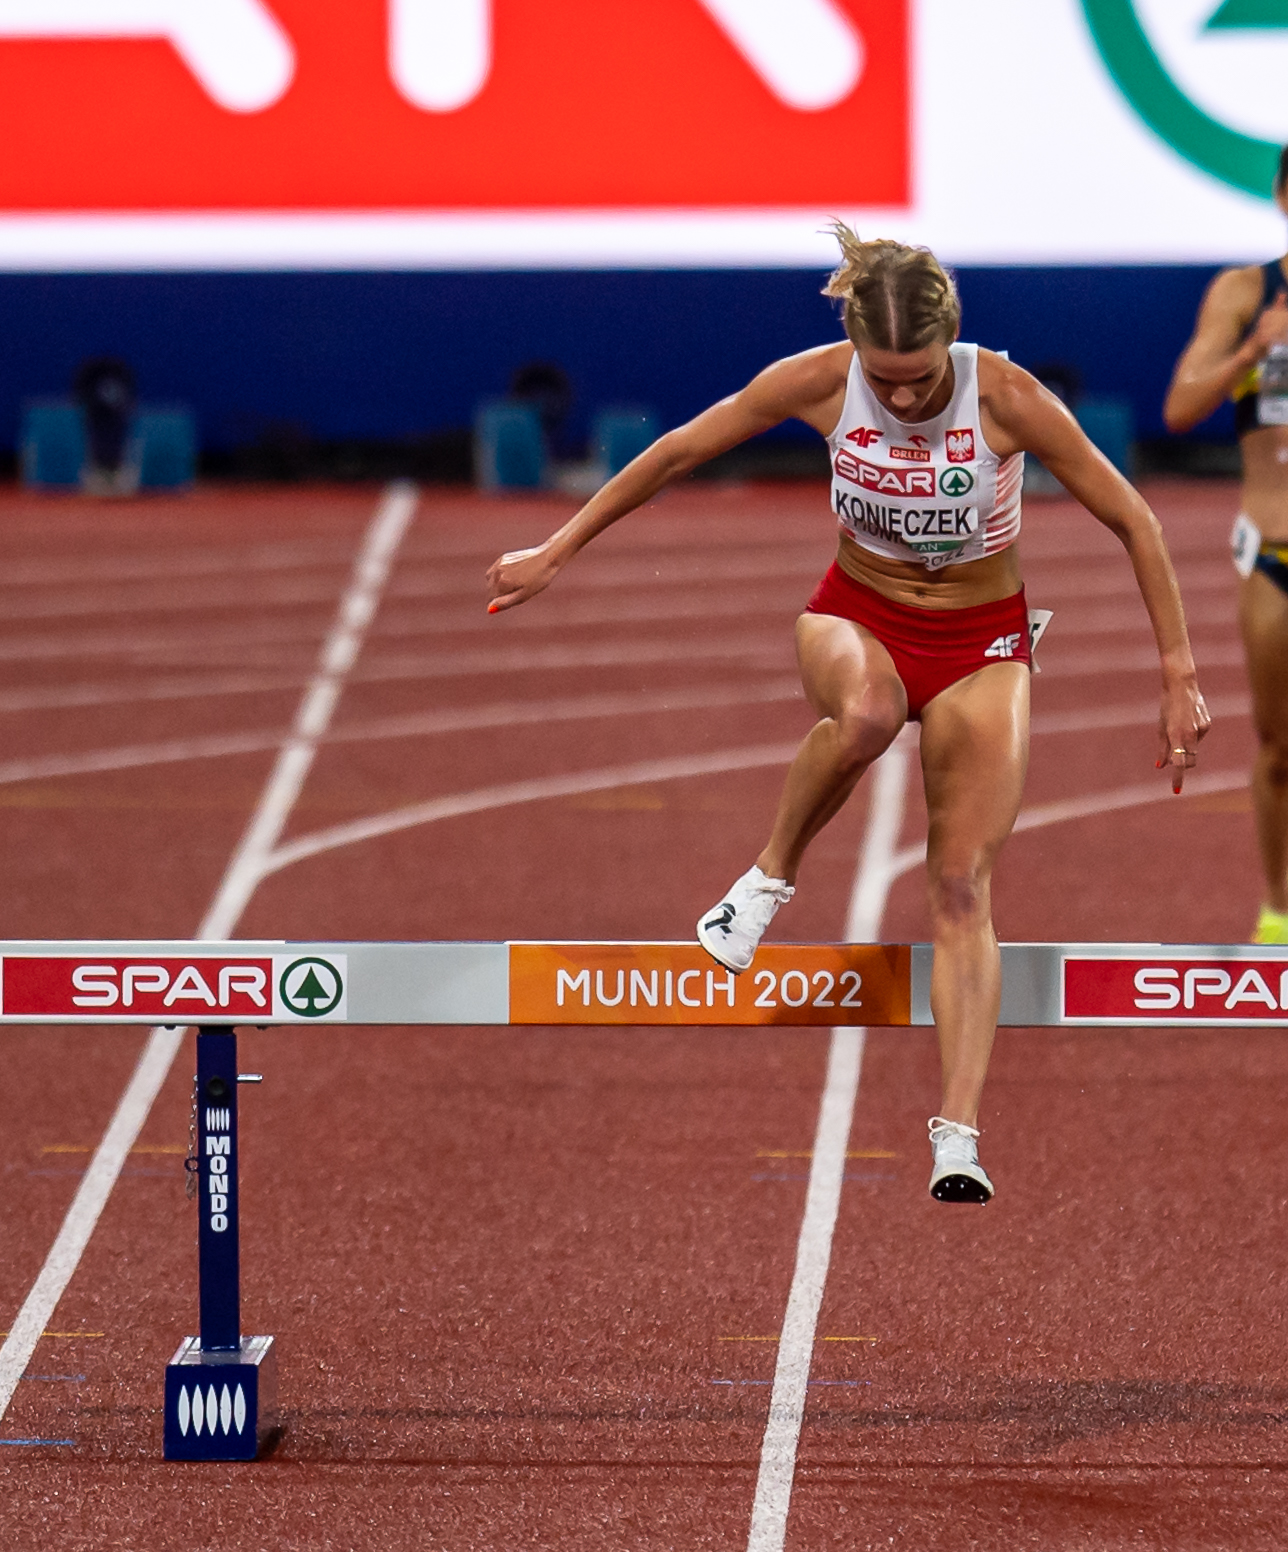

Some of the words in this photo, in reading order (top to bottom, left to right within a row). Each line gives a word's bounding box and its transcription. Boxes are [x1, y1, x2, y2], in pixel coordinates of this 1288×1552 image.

[846, 427, 884, 449] 4F
[892, 449, 930, 462] ORLEN
[837, 455, 932, 494] SPAR
[834, 489, 973, 536] KONIECZEK
[984, 633, 1021, 658] 4F
[72, 965, 267, 1007] SPAR
[556, 969, 735, 1007] MUNICH
[754, 970, 862, 1007] 2022
[206, 1136, 231, 1232] MONDO
